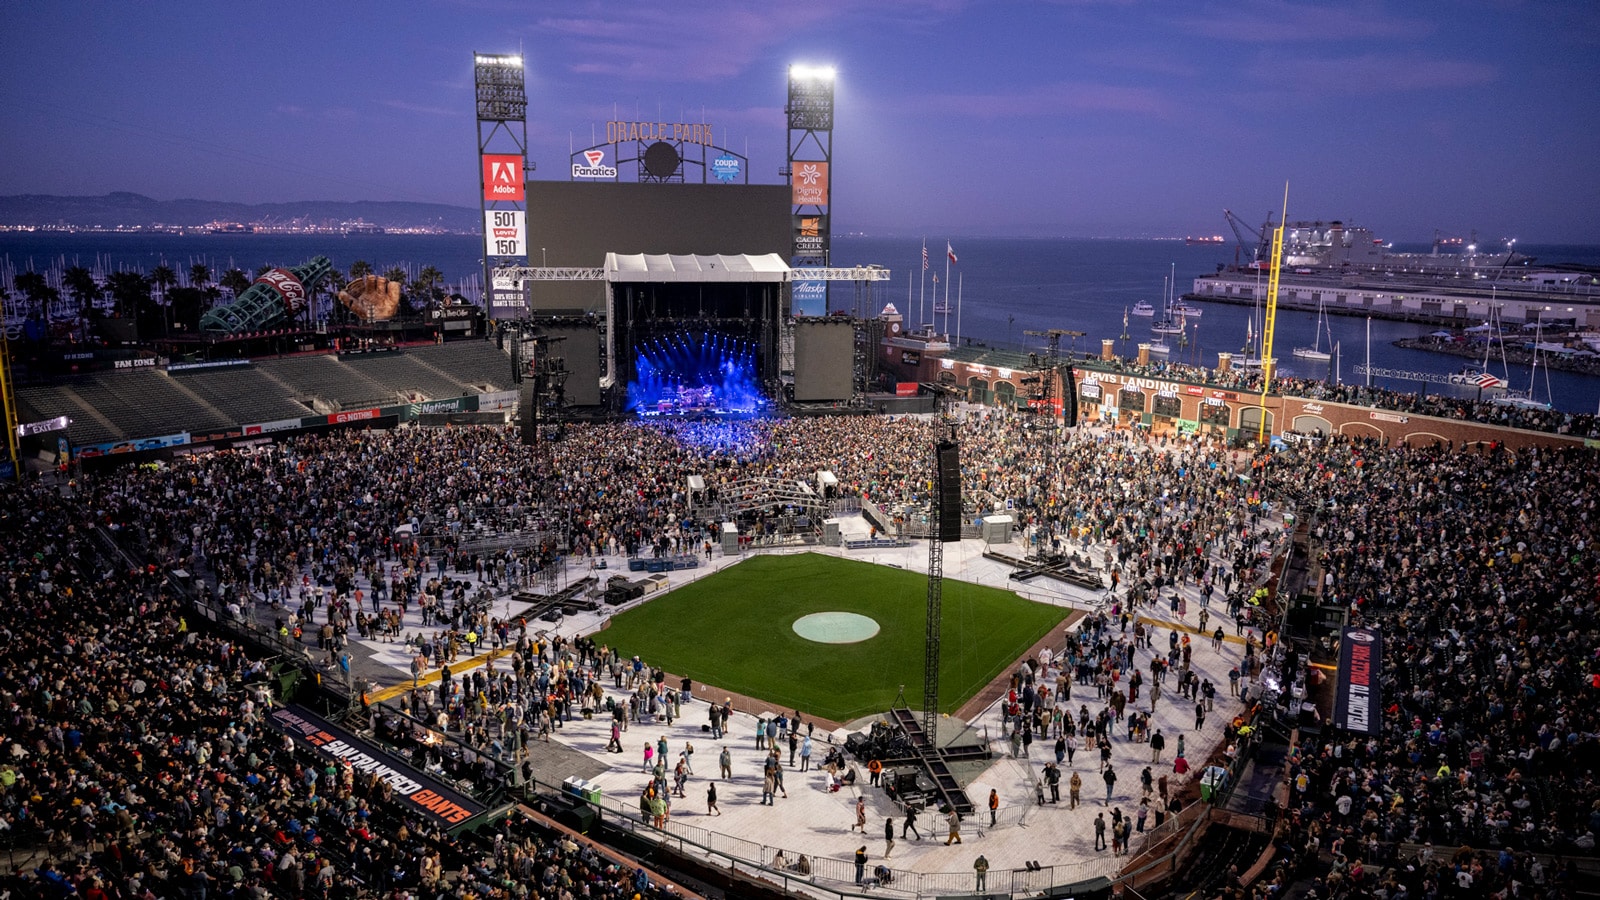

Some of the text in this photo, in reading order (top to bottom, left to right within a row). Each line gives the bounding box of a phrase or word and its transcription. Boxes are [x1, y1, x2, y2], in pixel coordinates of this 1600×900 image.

[606, 121, 713, 147] ORACLE PARK
[715, 159, 739, 168] coupa
[574, 165, 616, 176] Fanatics
[493, 185, 516, 194] Adobe
[797, 187, 823, 196] Dignity
[797, 196, 822, 204] Health
[494, 211, 516, 227] 501
[793, 281, 826, 294] Alaska
[114, 358, 155, 369] FAN ZONE
[1353, 365, 1387, 377] BANK
[1408, 371, 1469, 386] AMERICA
[1120, 375, 1179, 393] LANDING
[422, 400, 459, 413] National
[32, 423, 52, 434] EXIT
[1351, 644, 1370, 662] PARK
[1350, 661, 1370, 686] ORACLE
[1349, 684, 1370, 695] TO
[1347, 694, 1369, 732] WELCOME
[320, 740, 472, 823] SAN FRANCISCO GIANTS
